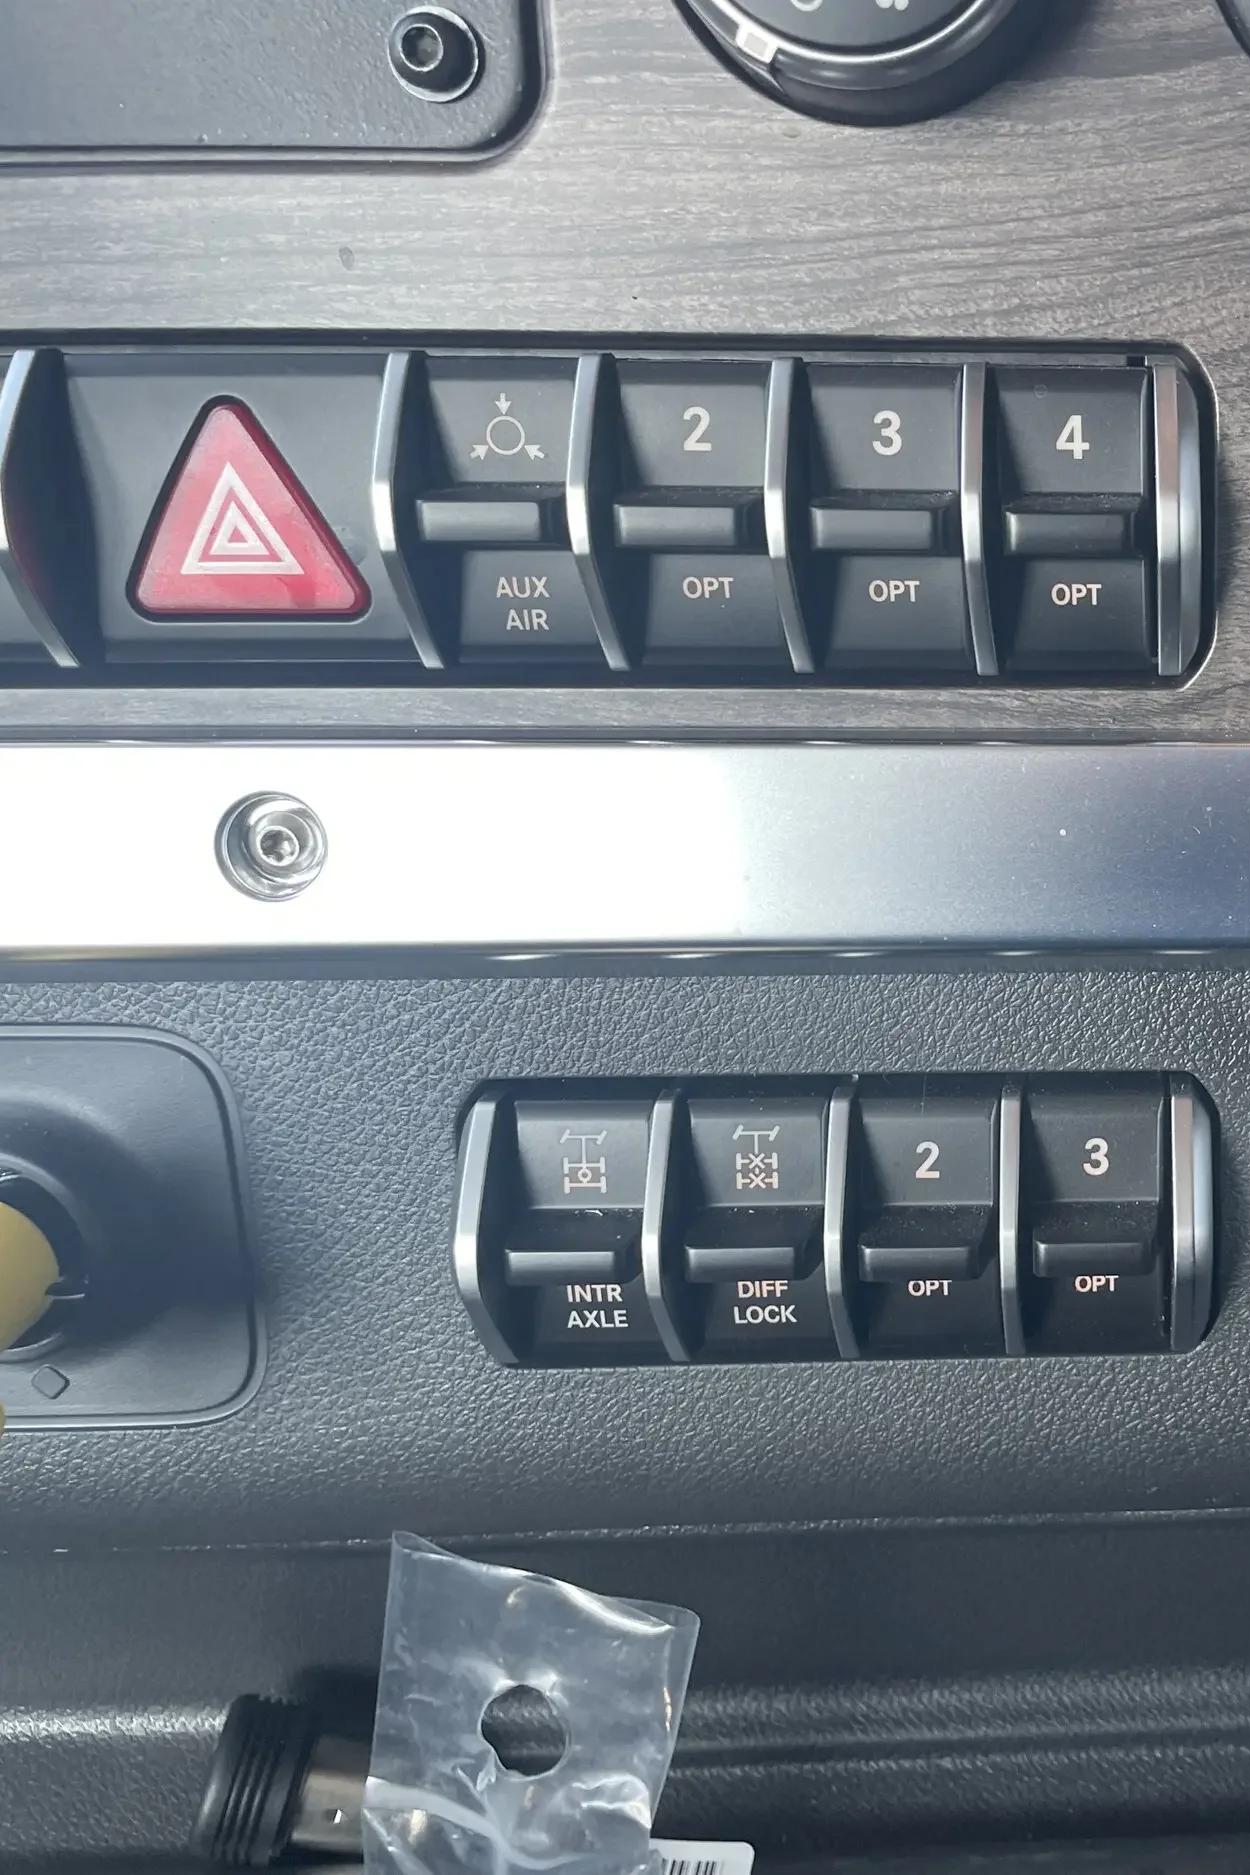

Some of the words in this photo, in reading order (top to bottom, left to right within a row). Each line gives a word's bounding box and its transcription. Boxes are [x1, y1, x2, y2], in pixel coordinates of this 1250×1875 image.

[683, 406, 712, 452] 2
[872, 410, 902, 456] 3
[1055, 414, 1090, 460] 4
[496, 576, 550, 598] AUX
[682, 576, 734, 599] OPT
[868, 579, 920, 602] OPT
[1051, 583, 1102, 606] OPT
[506, 608, 550, 631] AIR
[915, 1141, 940, 1179] 2
[1083, 1137, 1109, 1176] 3
[566, 1284, 623, 1303] INTR
[737, 1279, 789, 1299] DIFF
[908, 1279, 953, 1297] OPT
[1074, 1275, 1119, 1293] OPT
[567, 1309, 629, 1329] AXLE
[733, 1304, 797, 1324] LOCK
